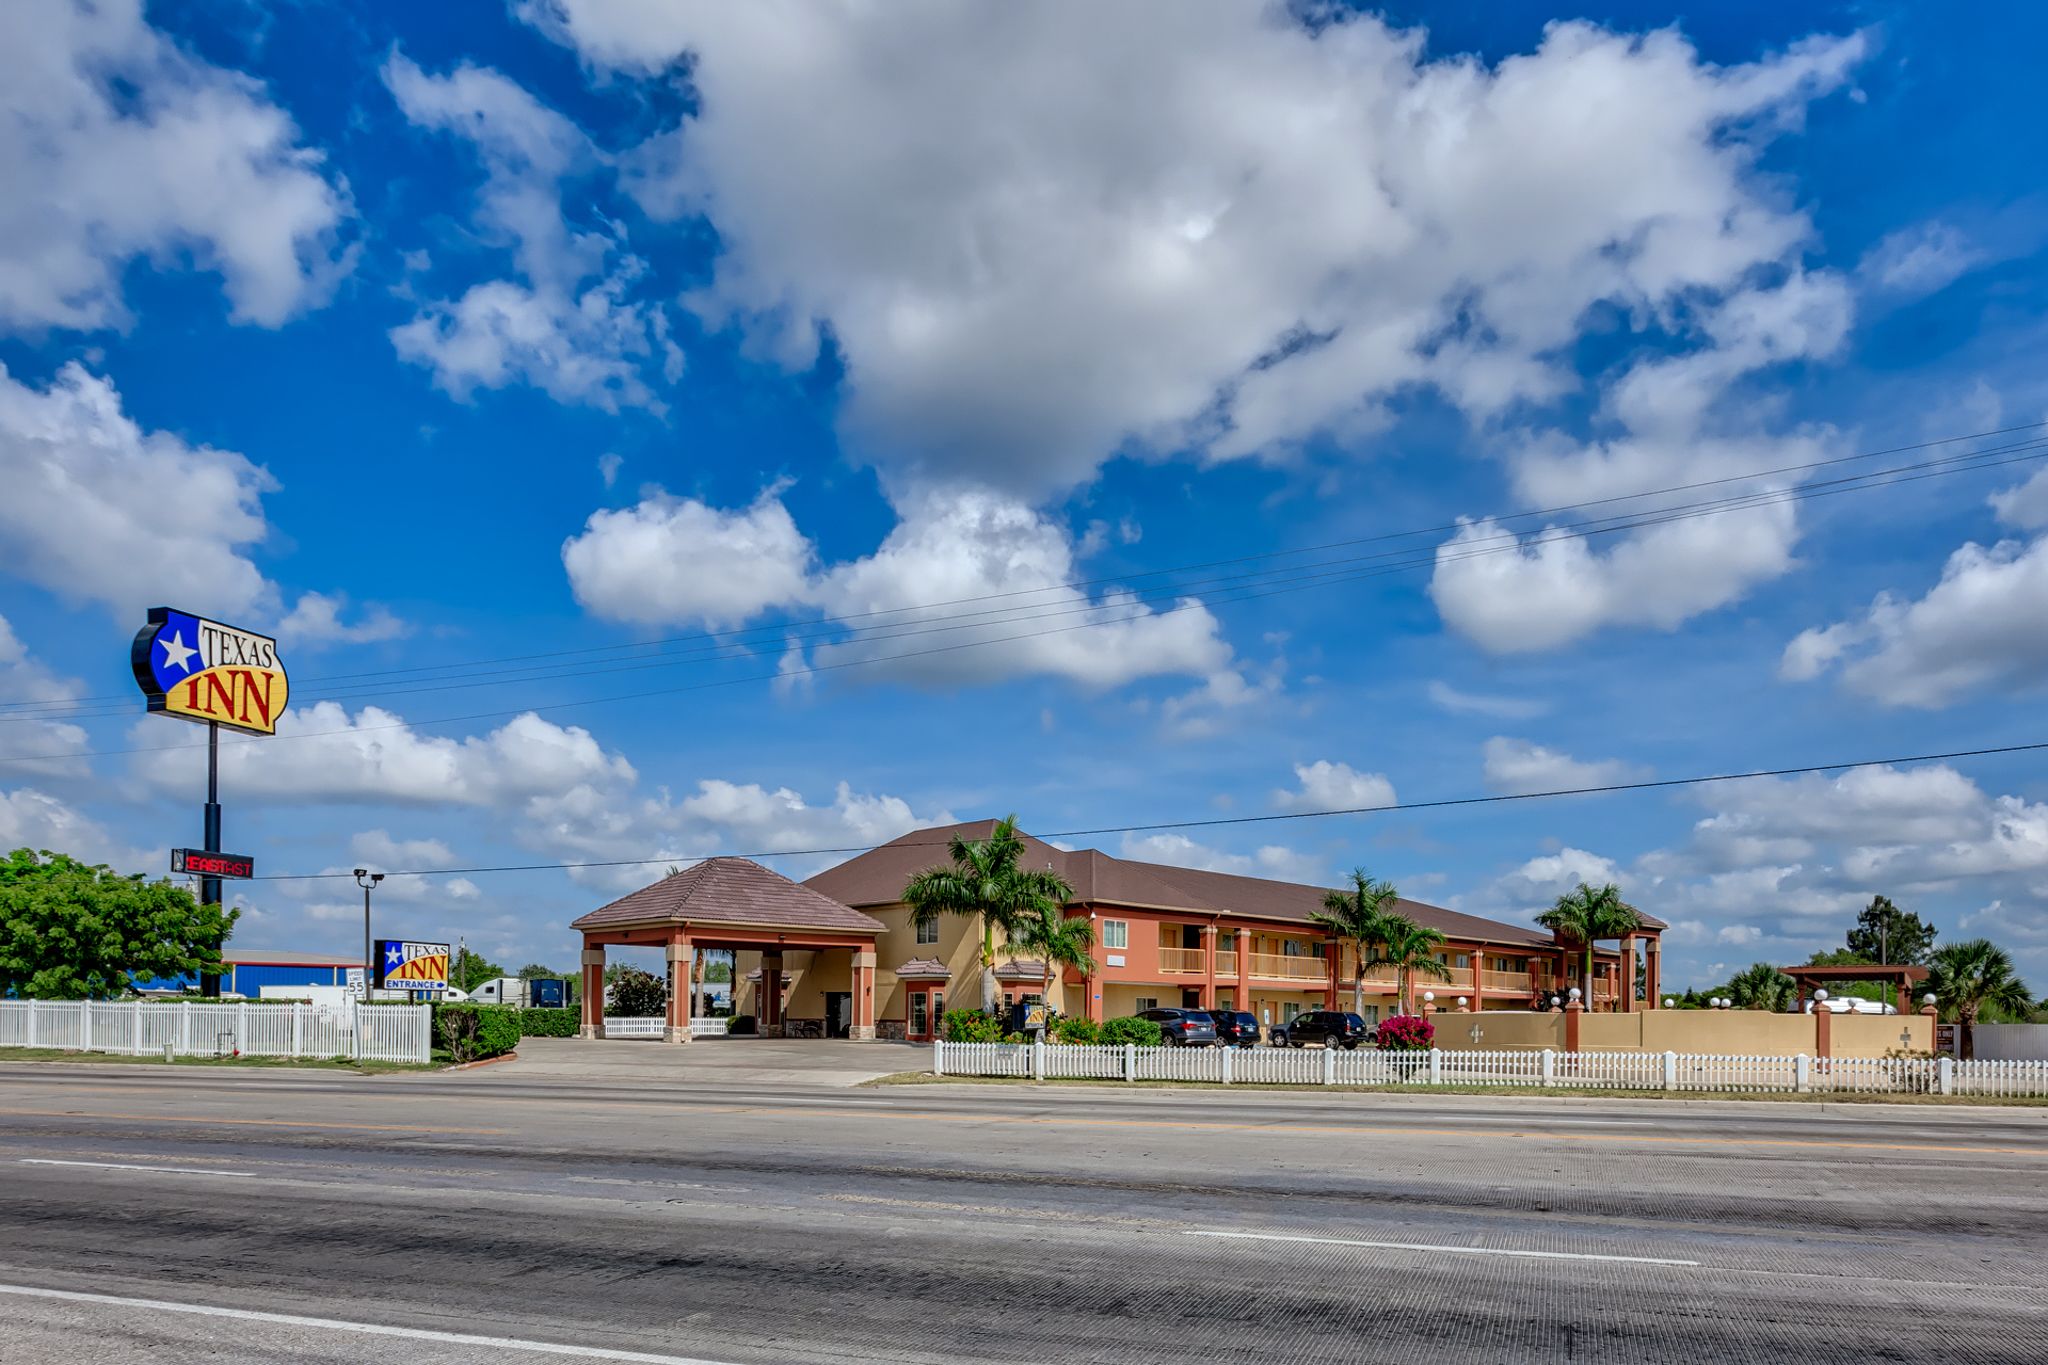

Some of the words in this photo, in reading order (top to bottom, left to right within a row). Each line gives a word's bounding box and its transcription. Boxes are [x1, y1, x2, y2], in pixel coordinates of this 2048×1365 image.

[202, 626, 272, 669] TEXAS
[185, 670, 274, 727] INN
[404, 944, 447, 960] TEXAS
[400, 955, 447, 980] INN
[349, 981, 364, 992] 55
[386, 980, 435, 989] ENTRANCE
